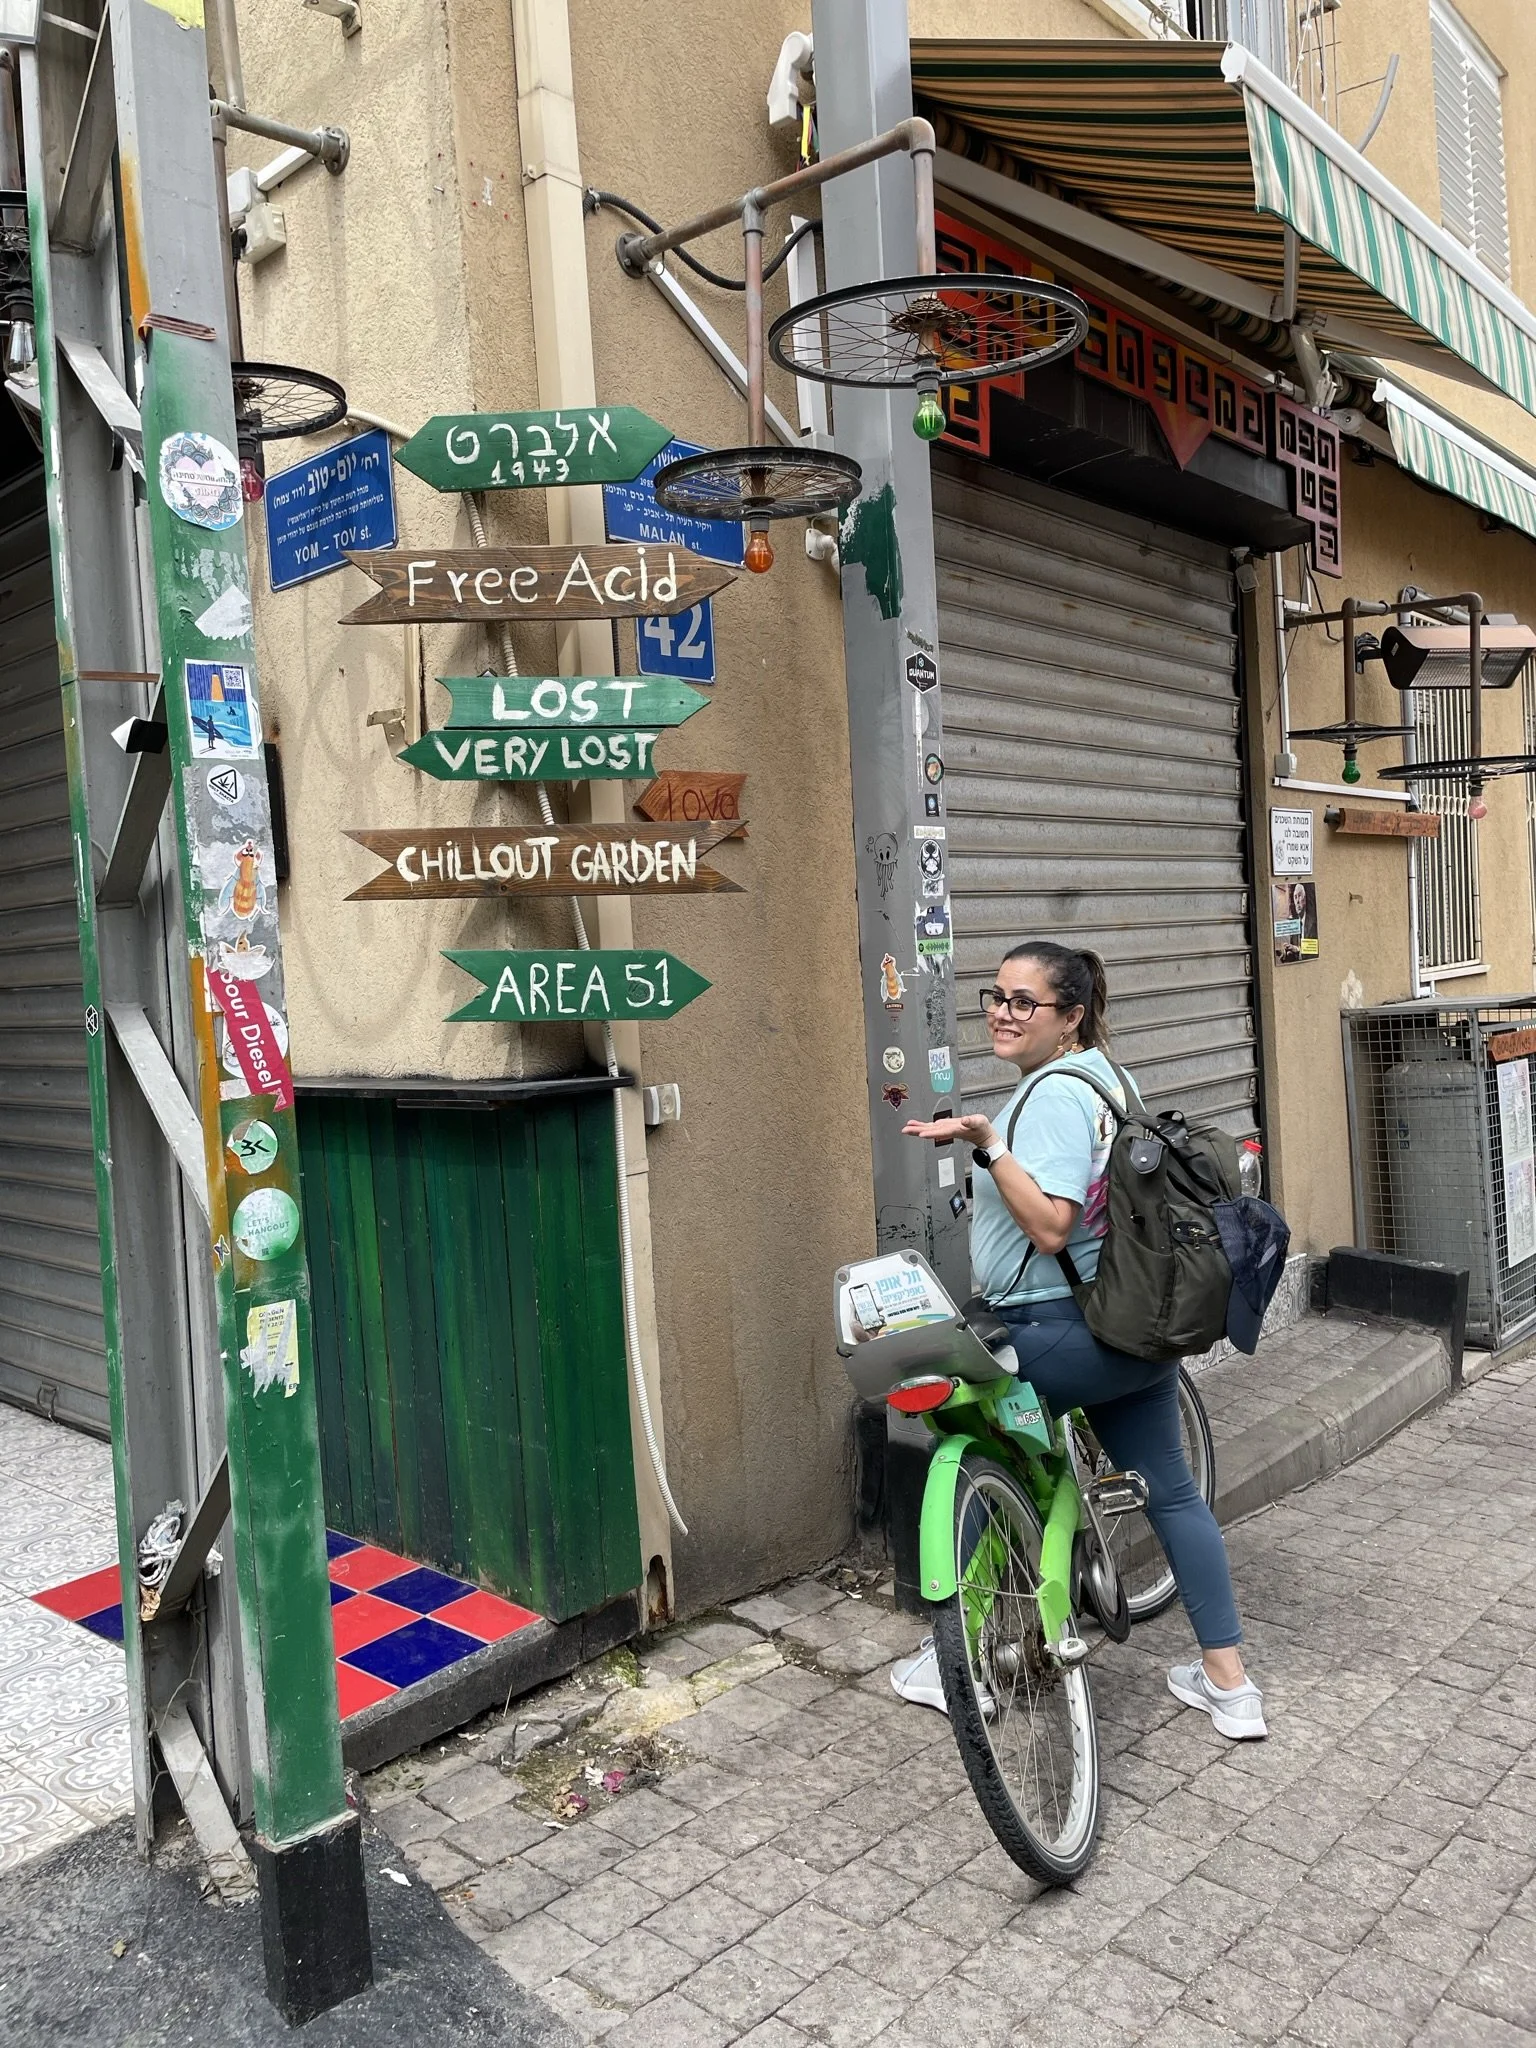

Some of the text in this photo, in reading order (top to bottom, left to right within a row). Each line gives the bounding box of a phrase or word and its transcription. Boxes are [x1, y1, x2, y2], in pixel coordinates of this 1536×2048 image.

[446, 411, 618, 465] אלברט
[490, 458, 570, 485] 1943
[630, 491, 645, 502] כרם
[639, 523, 702, 551] MALAN st.
[677, 516, 693, 527] העיר
[295, 541, 319, 565] YOM
[333, 526, 357, 549] TOV
[360, 526, 372, 540] st.
[407, 546, 678, 607] Free Acid
[644, 604, 706, 659] 42
[491, 680, 648, 723] LOST
[433, 732, 659, 776] VERY LOST
[571, 838, 697, 885] GARDEN
[490, 957, 674, 1015] AREA 51
[240, 1023, 282, 1089] Diesel
[248, 1221, 290, 1237] HANGOUT
[875, 1269, 922, 1295] תל אופן
